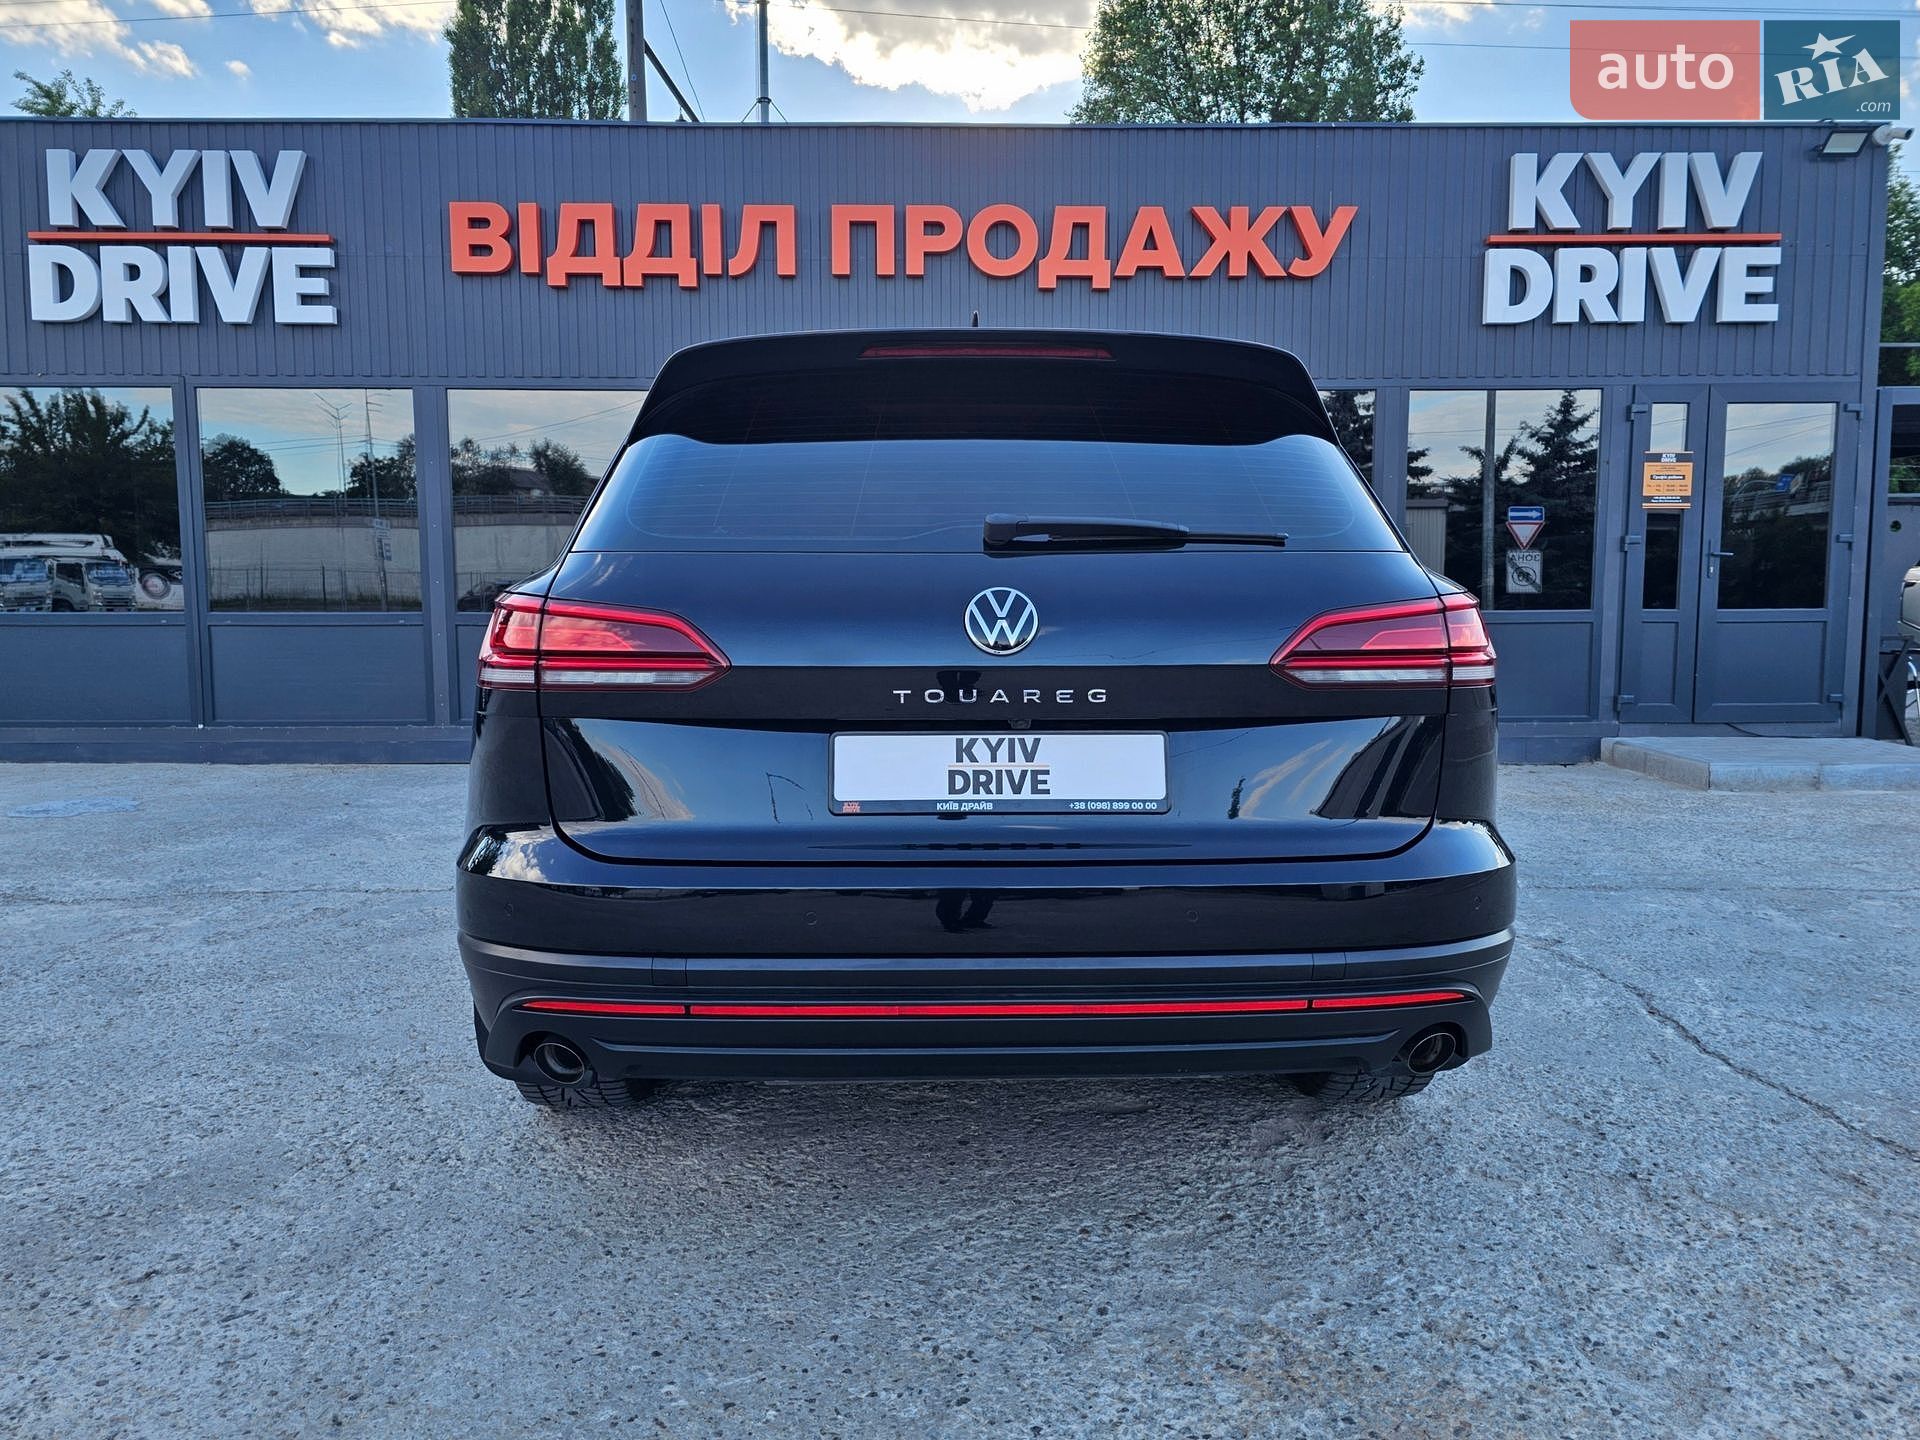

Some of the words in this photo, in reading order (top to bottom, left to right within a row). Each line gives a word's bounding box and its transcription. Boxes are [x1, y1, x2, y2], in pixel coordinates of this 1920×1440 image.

[45, 148, 306, 229] KYIV
[1508, 151, 1763, 231] KYIV
[449, 201, 797, 290] ВІДДІЛ
[831, 204, 1359, 291] ПРОДАЖУ
[28, 244, 338, 325] DRIVE
[1482, 246, 1782, 324] DRIVE
[892, 688, 1108, 704] TOUAREG
[955, 737, 1041, 763] KYIV
[936, 801, 959, 811] КИЇВ
[960, 801, 993, 812] ДРАЙВ
[947, 768, 1051, 795] DRIVE
[1069, 801, 1086, 810] +38
[1112, 801, 1130, 810] 899
[1131, 801, 1144, 810] 00
[1145, 801, 1158, 810] 00
